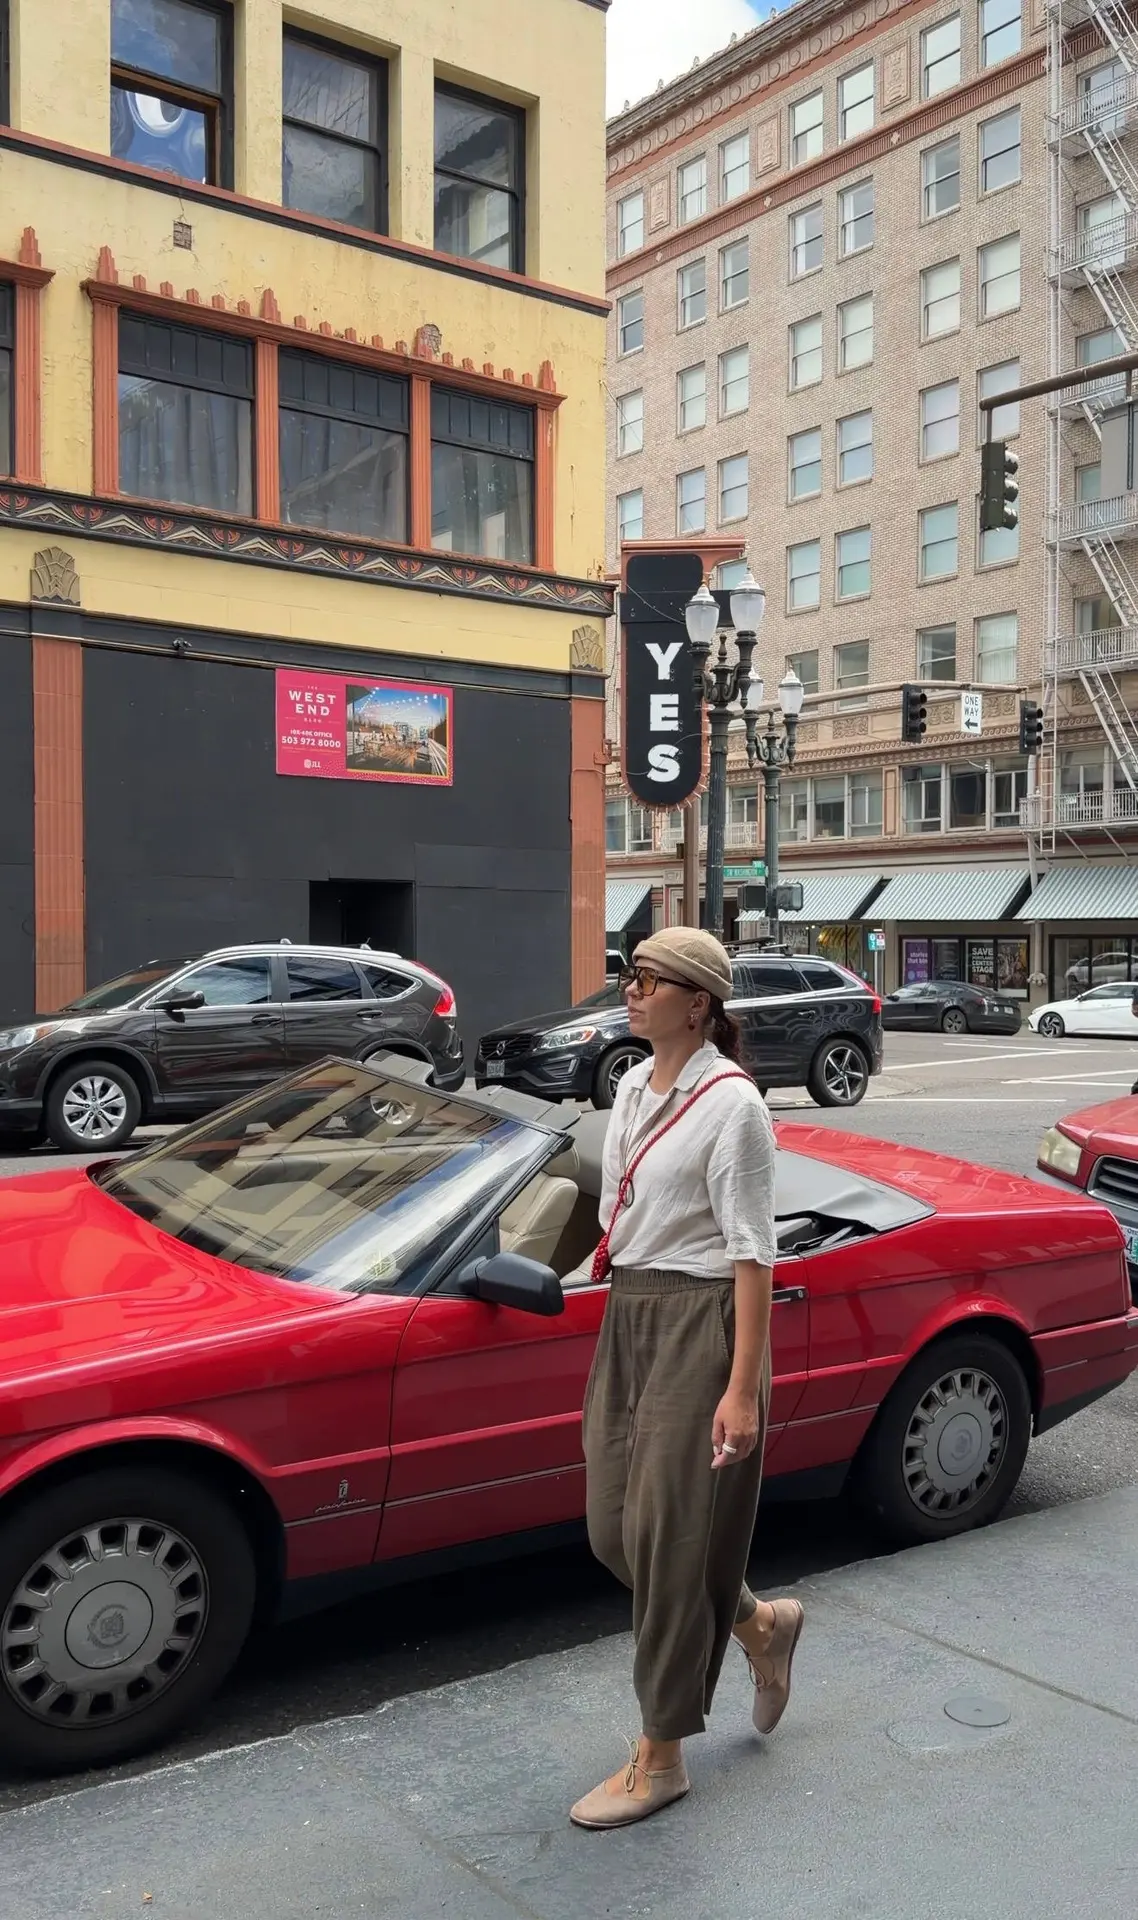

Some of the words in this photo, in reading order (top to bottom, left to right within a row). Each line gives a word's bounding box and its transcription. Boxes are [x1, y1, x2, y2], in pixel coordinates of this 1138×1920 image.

[289, 690, 336, 704] WEST
[964, 695, 979, 706] ONE
[295, 704, 330, 716] END
[645, 642, 684, 783] YES
[964, 707, 979, 716] WAY
[281, 735, 298, 745] 503
[300, 737, 316, 746] 972
[317, 739, 341, 748] 8000
[972, 947, 994, 956] SAVE
